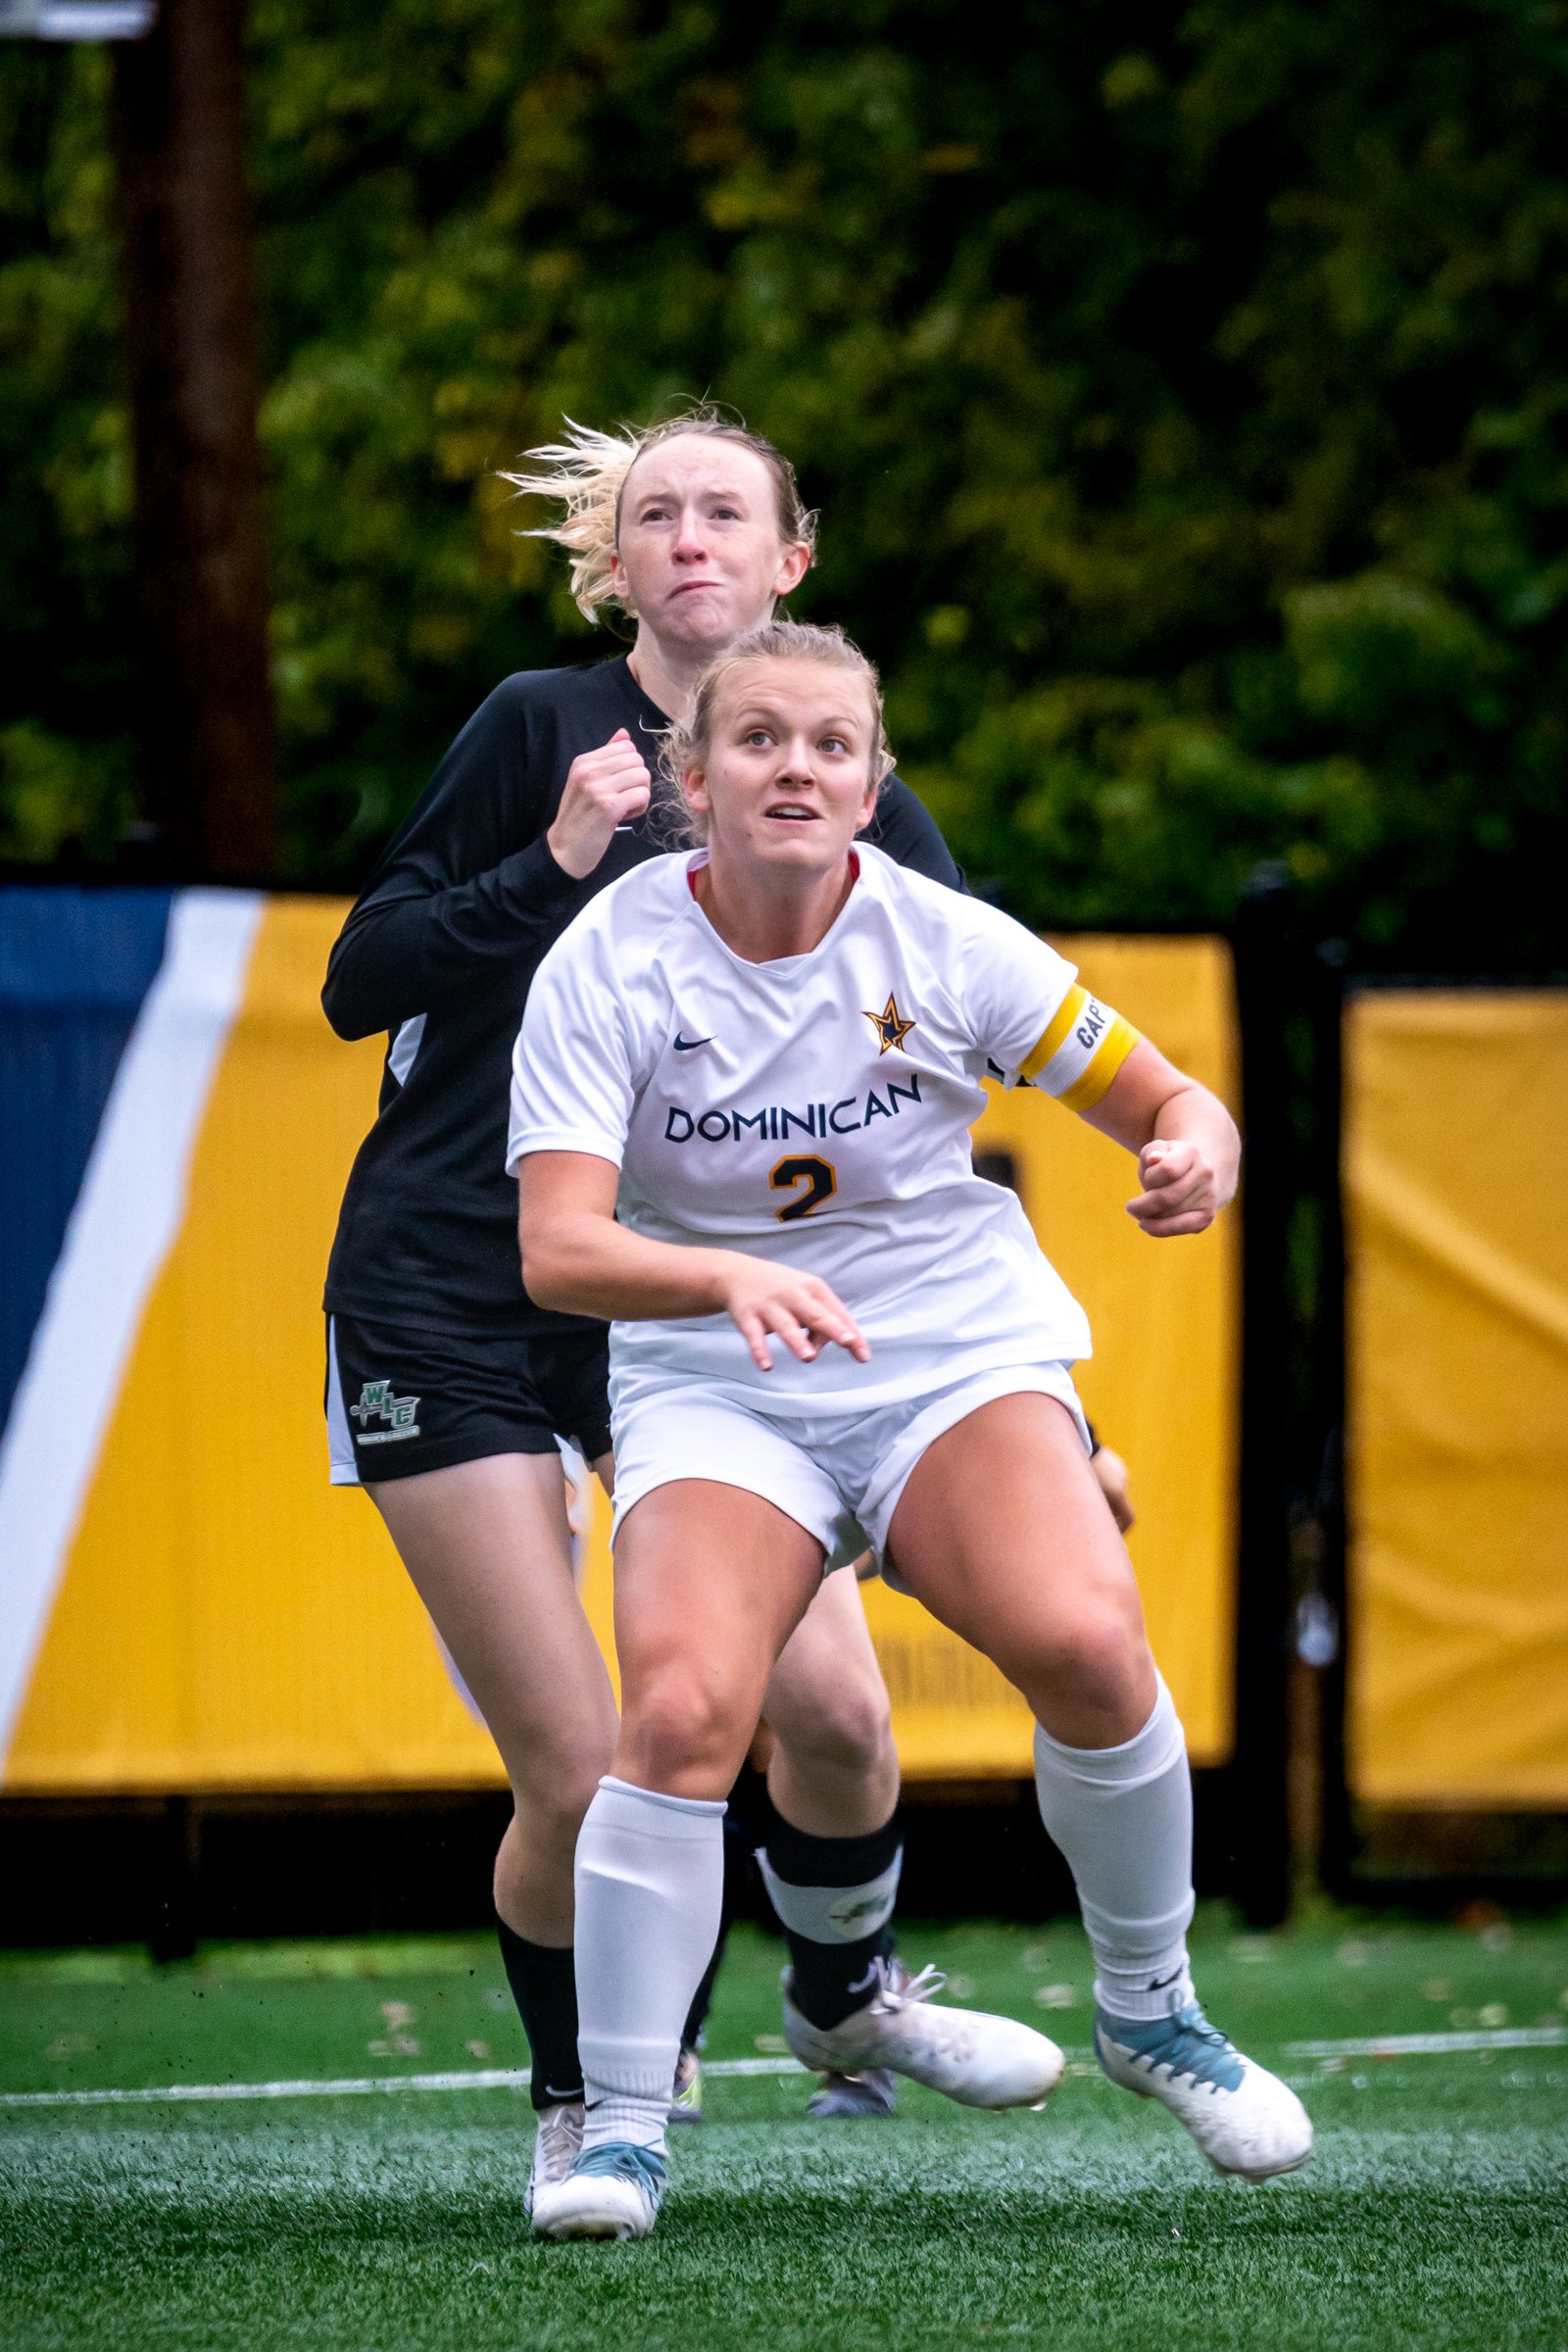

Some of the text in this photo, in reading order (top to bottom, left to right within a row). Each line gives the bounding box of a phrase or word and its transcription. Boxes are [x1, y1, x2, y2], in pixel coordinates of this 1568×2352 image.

[1076, 998, 1106, 1050] CAP
[664, 1073, 922, 1143] DOMINICAN
[769, 1154, 838, 1223] 2
